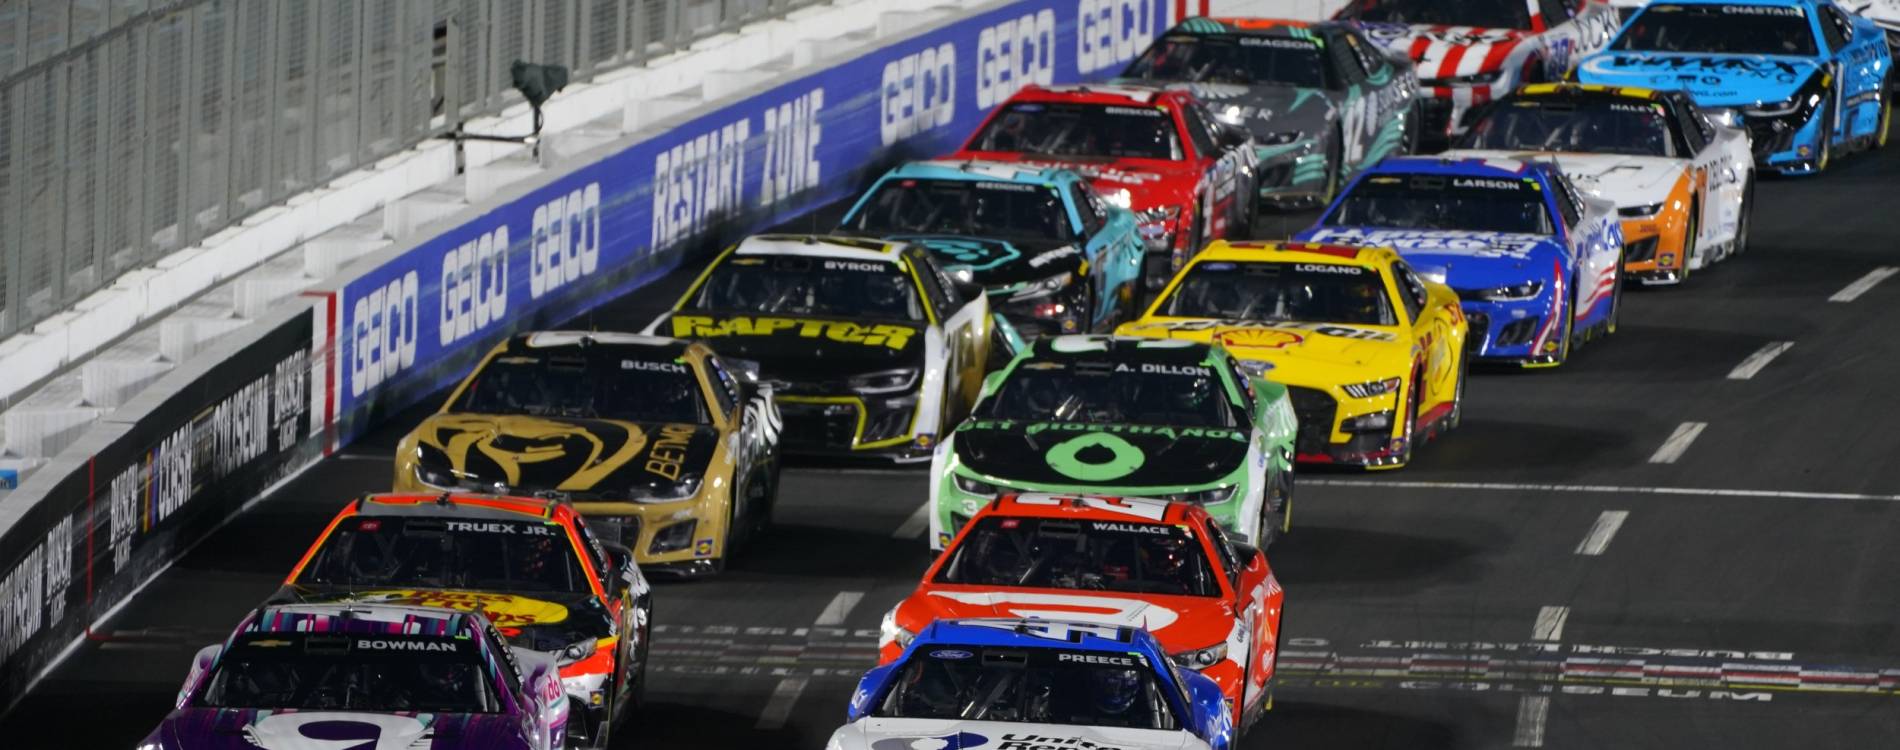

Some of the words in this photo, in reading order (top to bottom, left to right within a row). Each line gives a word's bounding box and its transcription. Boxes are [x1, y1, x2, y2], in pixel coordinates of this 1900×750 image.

[1722, 5, 1802, 17] CHASTAIN
[1077, 0, 1154, 74] GEICO
[976, 8, 1056, 111] GEICO
[881, 42, 957, 147] GEICO
[650, 117, 750, 256] RESTART
[760, 87, 825, 207] ZONE
[1453, 178, 1520, 190] LARSON
[530, 181, 600, 300] GEICO
[824, 260, 885, 272] BYRON
[1295, 263, 1362, 275] LOGANO
[439, 224, 509, 347] GEICO
[351, 269, 419, 398] GEICO
[672, 315, 917, 350] RAPTOR
[620, 359, 687, 374] BUSCH
[1115, 362, 1136, 373] A.
[1141, 363, 1211, 376] DILLON
[159, 419, 192, 523] CLASH
[447, 521, 517, 534] TRUEX
[522, 524, 556, 536] JR.
[1092, 521, 1169, 535] WALLACE
[357, 639, 457, 652] BOWMAN
[1058, 652, 1134, 666] PREECE
